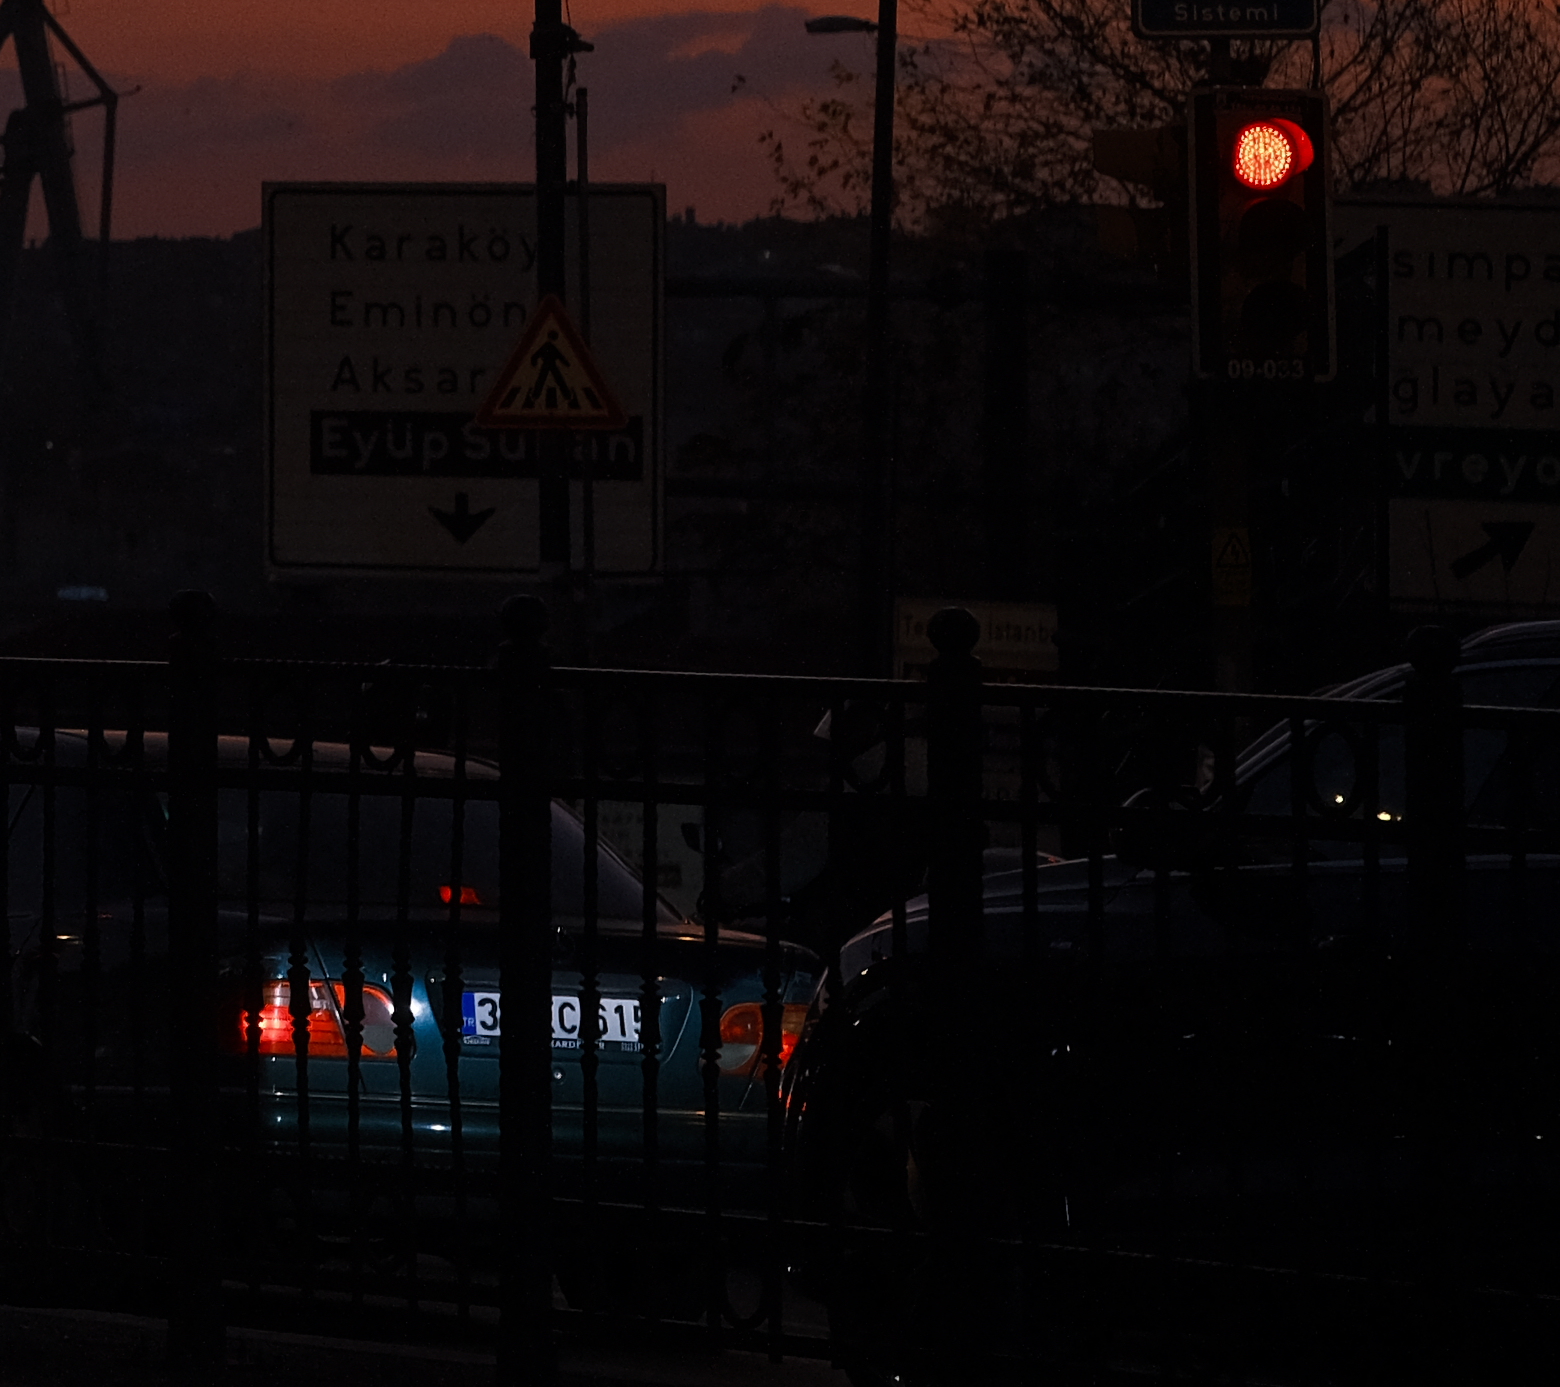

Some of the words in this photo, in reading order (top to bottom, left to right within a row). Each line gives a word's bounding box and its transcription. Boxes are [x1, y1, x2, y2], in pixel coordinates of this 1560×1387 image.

[1174, 2, 1278, 21] Sistemi
[331, 224, 537, 271] Karaköy
[331, 291, 527, 327] Eminön
[331, 356, 486, 393] Aksar
